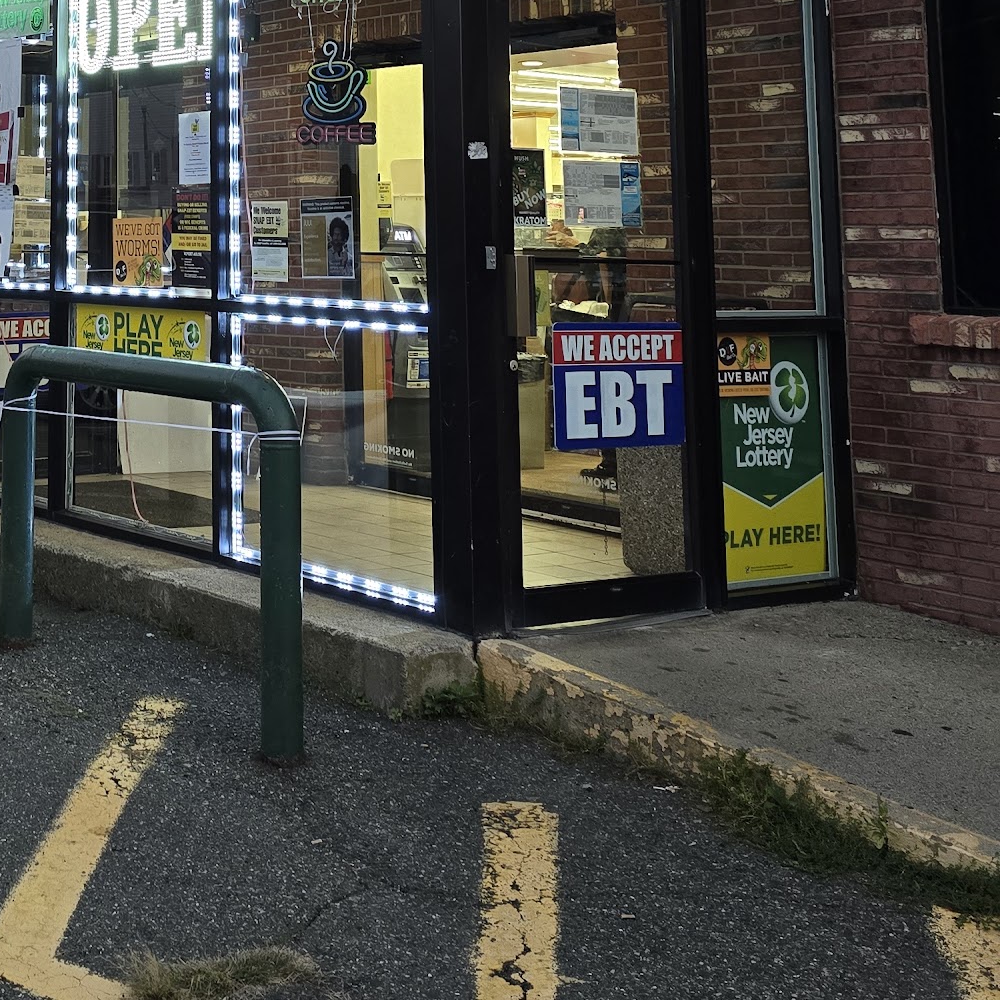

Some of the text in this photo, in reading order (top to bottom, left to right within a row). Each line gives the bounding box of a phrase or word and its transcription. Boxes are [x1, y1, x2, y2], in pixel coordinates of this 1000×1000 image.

[296, 124, 375, 144] COFFEE
[513, 188, 530, 207] BUY
[524, 188, 546, 210] NOW
[261, 206, 281, 214] Welcome
[115, 222, 160, 236] WE'VE GOT
[253, 216, 265, 224] SNAP
[394, 230, 412, 241] ATM
[115, 239, 160, 257] WORMS!
[83, 330, 95, 340] New
[113, 312, 164, 340] PLAY
[85, 340, 104, 351] Jersey
[169, 337, 184, 348] New
[561, 334, 675, 362] WE ACCEPT
[172, 347, 194, 360] Jersey
[718, 371, 768, 383] LIVE BAIT
[564, 369, 673, 440] EBT
[733, 403, 770, 424] New
[743, 424, 794, 449] Jersey
[735, 446, 794, 469] Lottery
[769, 524, 821, 546] HERE!
